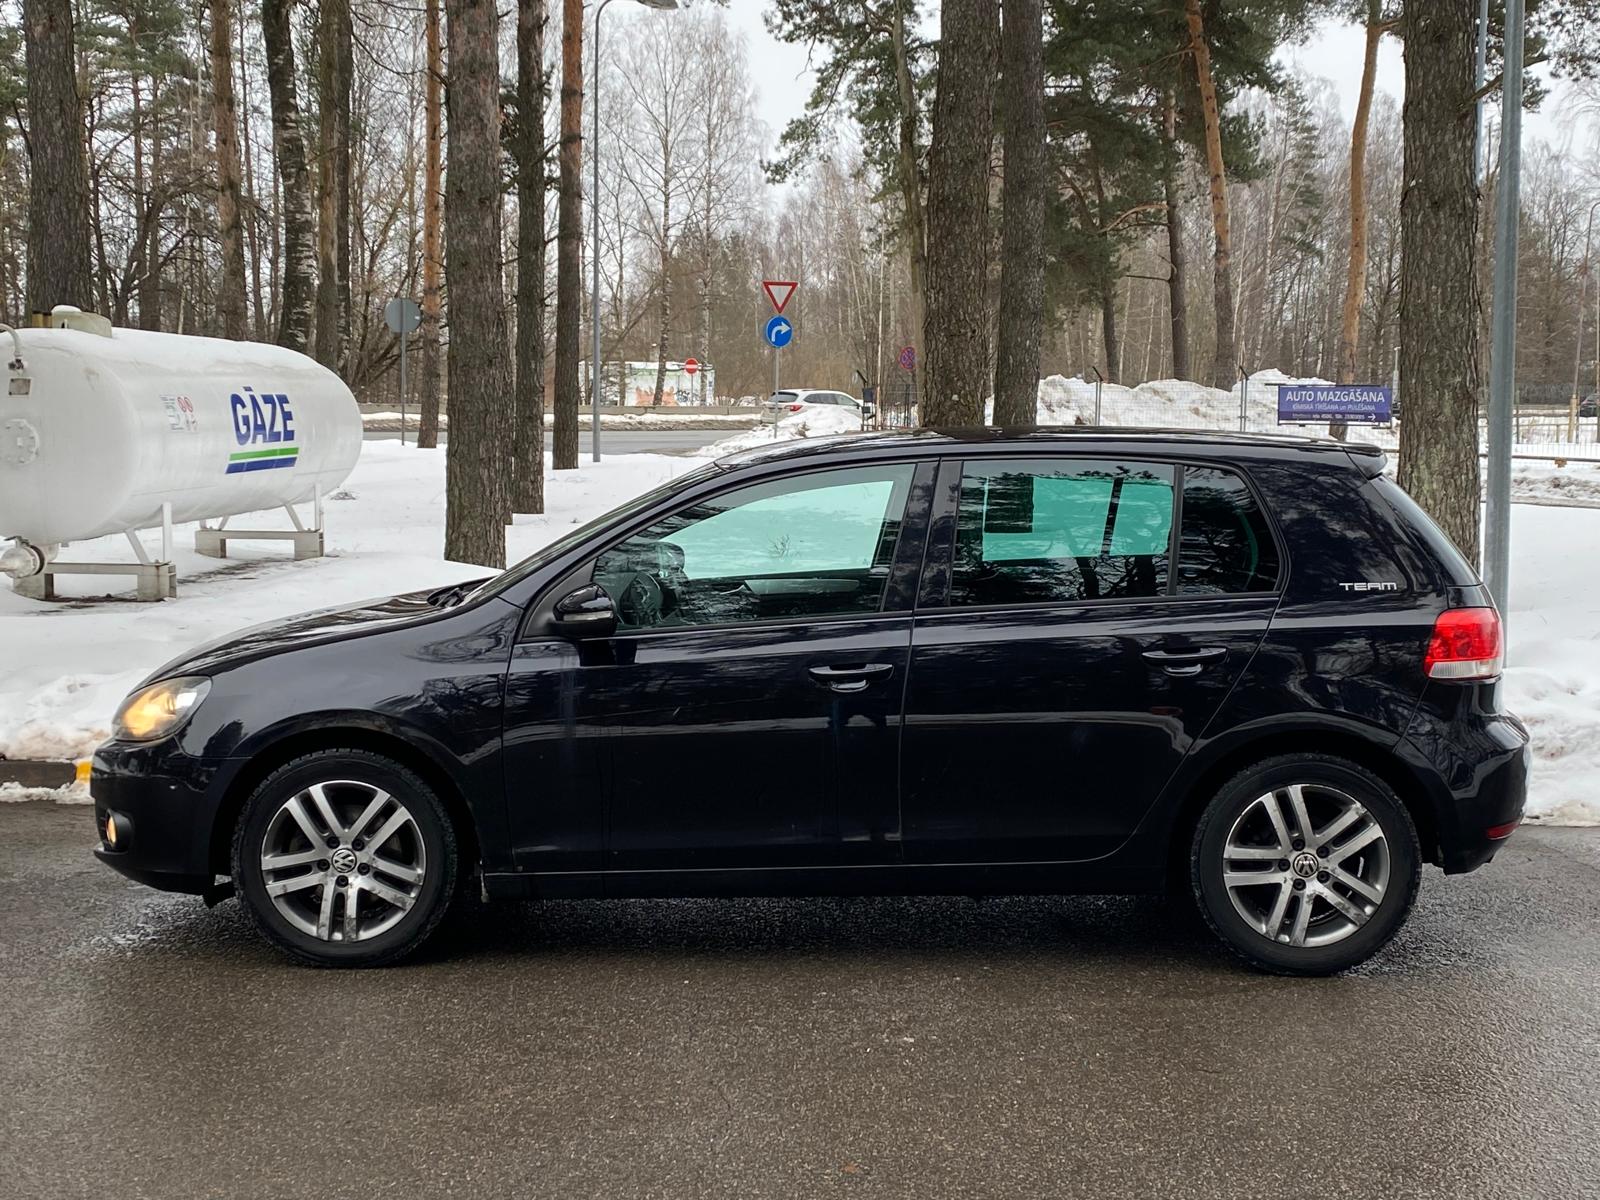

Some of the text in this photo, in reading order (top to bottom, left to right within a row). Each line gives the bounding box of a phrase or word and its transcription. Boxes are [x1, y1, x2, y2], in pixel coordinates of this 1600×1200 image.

[1286, 389, 1385, 403] AUTO MAZGĀŠANA
[230, 386, 295, 446] GĀZE
[1339, 582, 1397, 591] TEAM
